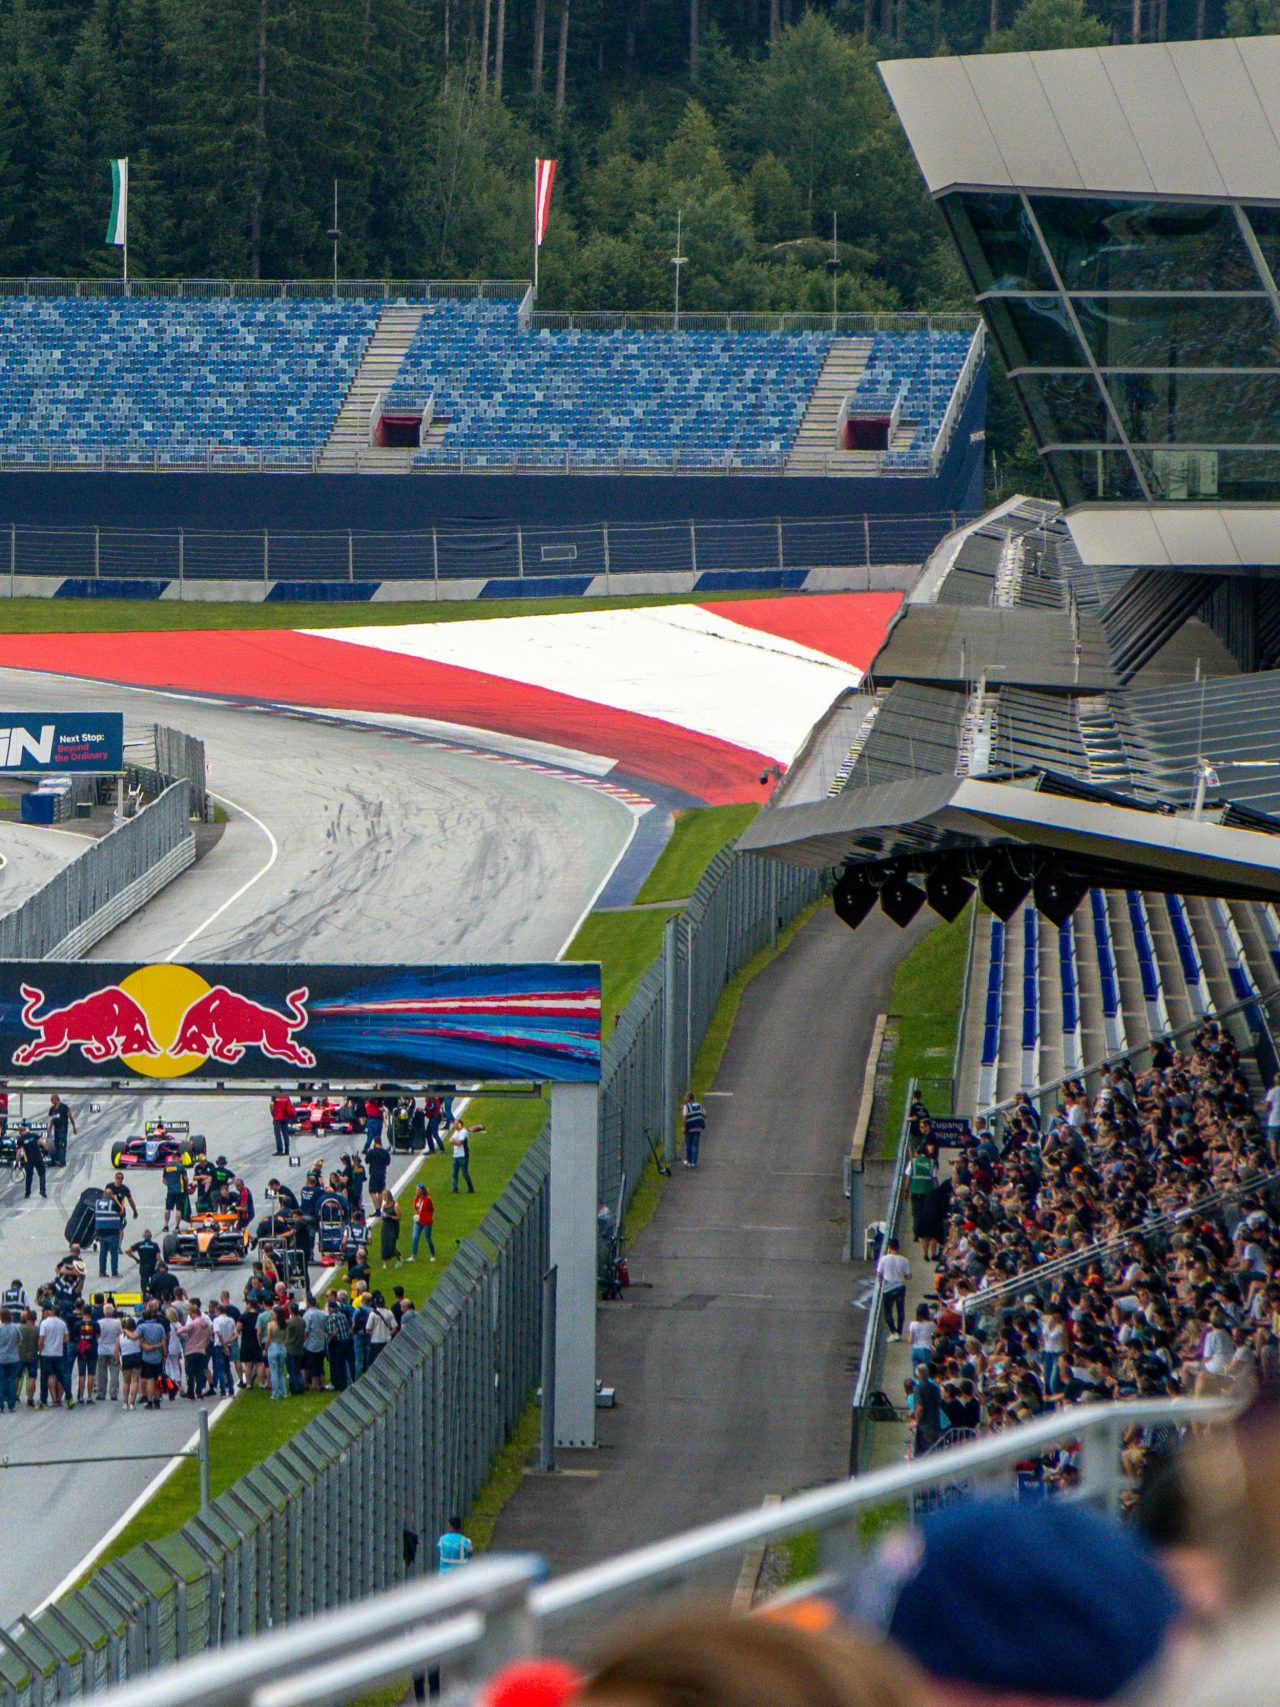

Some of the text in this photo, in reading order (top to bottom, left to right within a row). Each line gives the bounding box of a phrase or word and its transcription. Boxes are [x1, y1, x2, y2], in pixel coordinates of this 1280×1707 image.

[59, 733, 105, 743] Next Stop:
[57, 743, 90, 753] Beyond
[55, 752, 108, 763] the Ordinary
